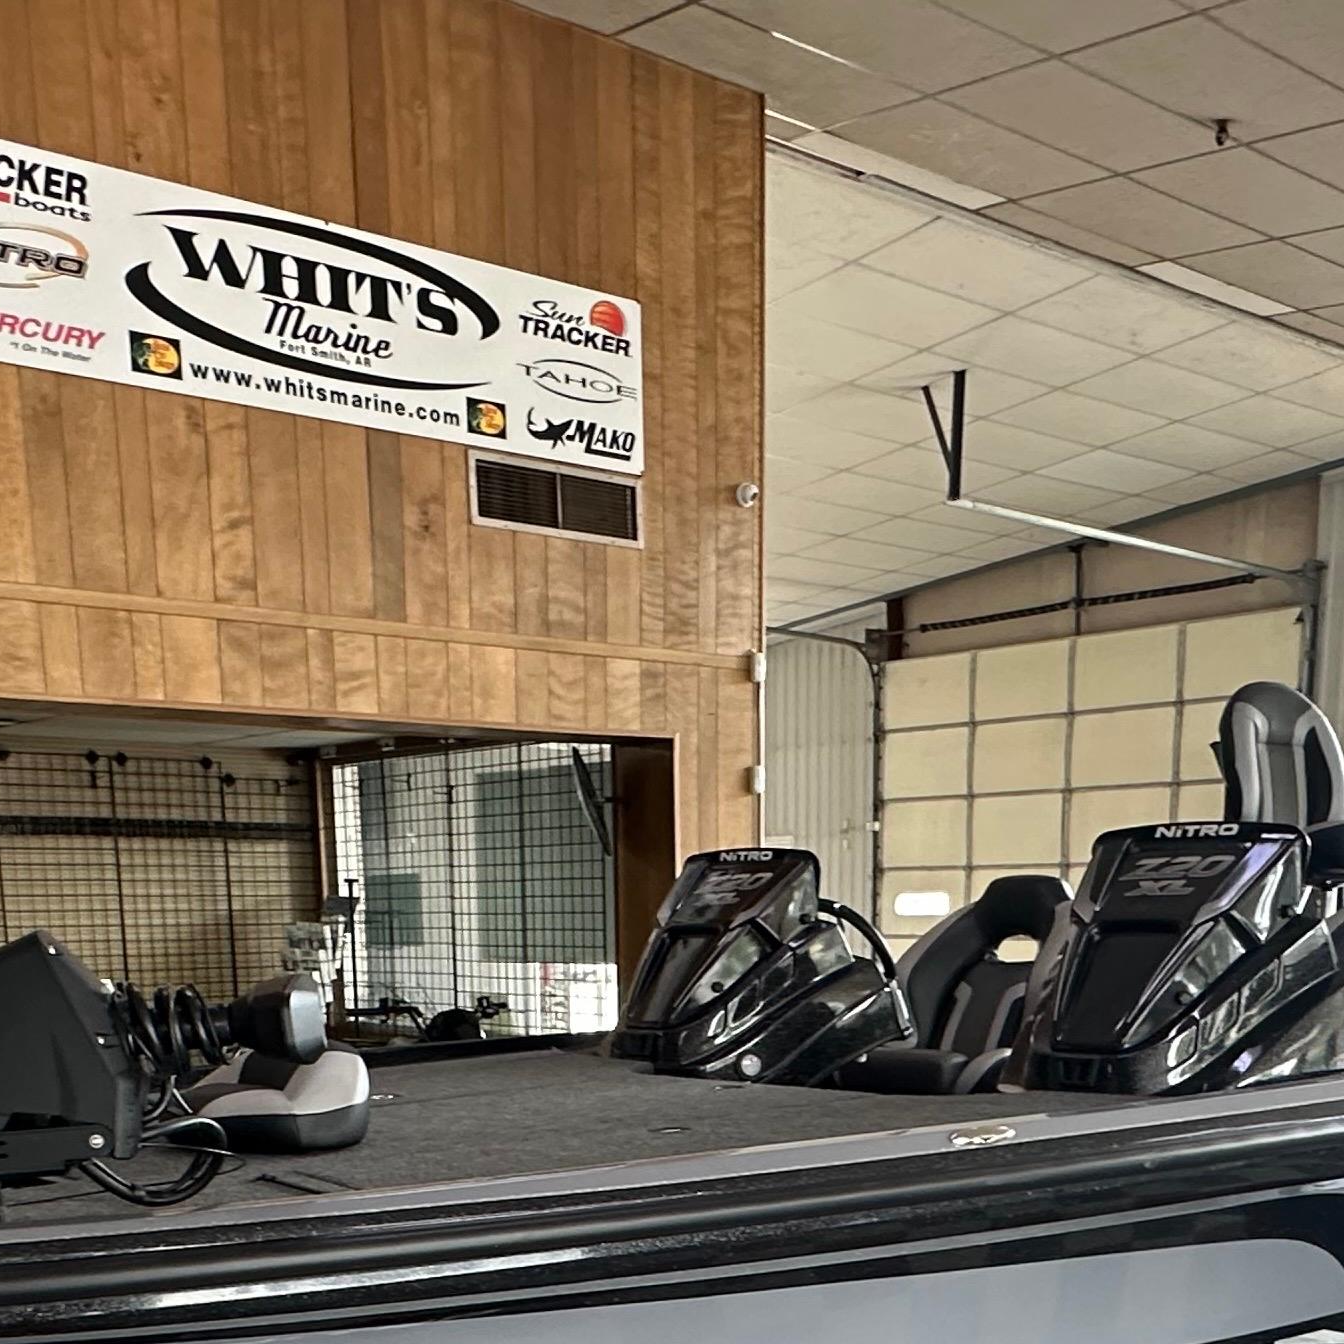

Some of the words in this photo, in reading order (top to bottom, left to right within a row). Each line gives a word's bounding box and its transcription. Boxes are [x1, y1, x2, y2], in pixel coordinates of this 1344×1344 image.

[14, 192, 92, 222] boats
[163, 224, 459, 336] WHIT'S
[263, 297, 393, 358] Marine
[527, 300, 586, 328] Sun
[280, 340, 307, 354] Fort
[311, 350, 352, 366] Smith,
[355, 356, 372, 368] AR
[519, 314, 632, 358] TRACKER
[189, 362, 460, 427] www.whitsmarine.com
[516, 362, 638, 401] TAHOE
[566, 418, 636, 461] MAKO
[1119, 855, 1237, 881] Z20
